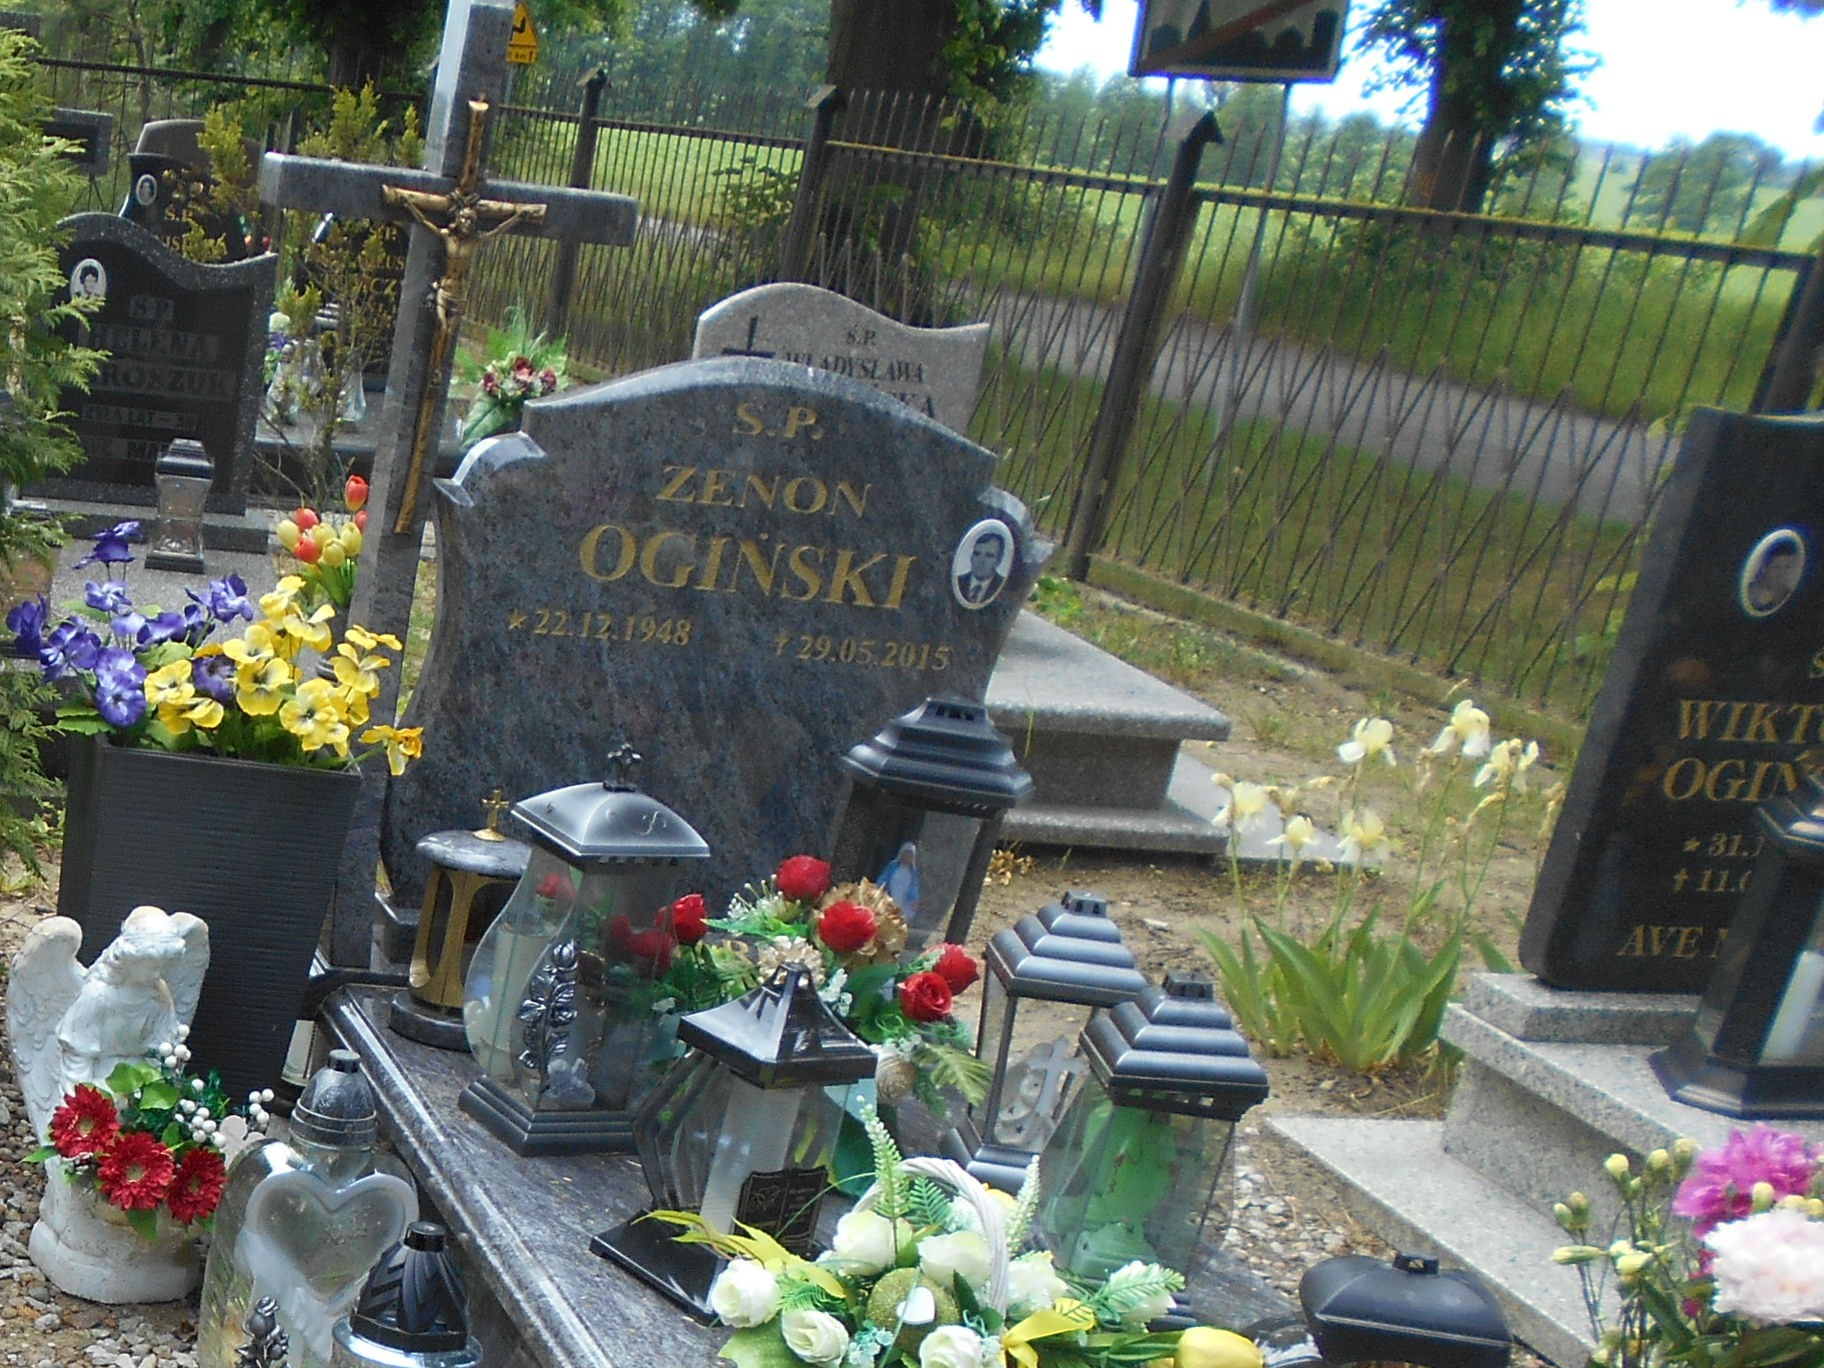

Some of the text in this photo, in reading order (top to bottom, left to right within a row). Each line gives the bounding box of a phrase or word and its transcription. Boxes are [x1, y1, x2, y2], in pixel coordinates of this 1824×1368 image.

[96, 363, 229, 396] ROSZUK
[656, 464, 874, 519] ZENON
[533, 608, 953, 673] 22.12.1948 29.05.2015
[1678, 699, 1824, 745] WIKT
[1617, 925, 1704, 959] AVE
